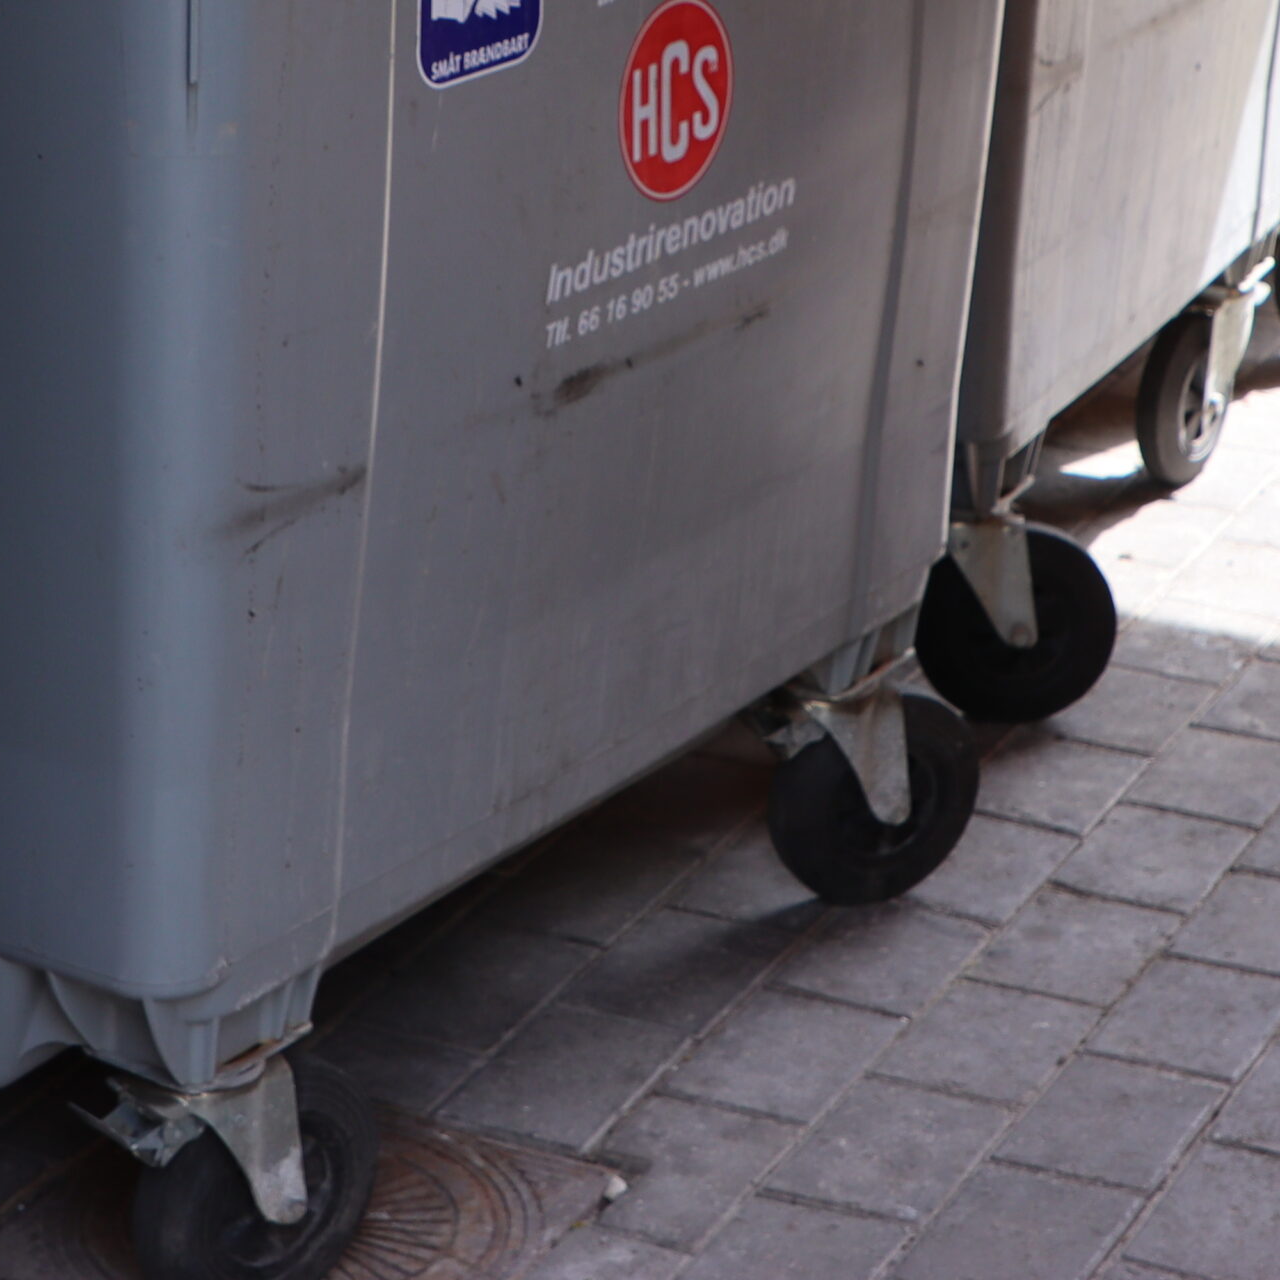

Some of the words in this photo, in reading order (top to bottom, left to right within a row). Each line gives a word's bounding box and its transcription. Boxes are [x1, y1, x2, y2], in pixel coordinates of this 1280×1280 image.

[431, 51, 462, 81] SMÅT
[632, 39, 719, 163] HCS
[546, 177, 796, 305] Industrirenovation
[577, 305, 601, 336] 66
[606, 293, 628, 324] 16
[631, 284, 655, 315] 90
[657, 272, 680, 303] 55
[693, 225, 790, 288] www.hcs.dk
